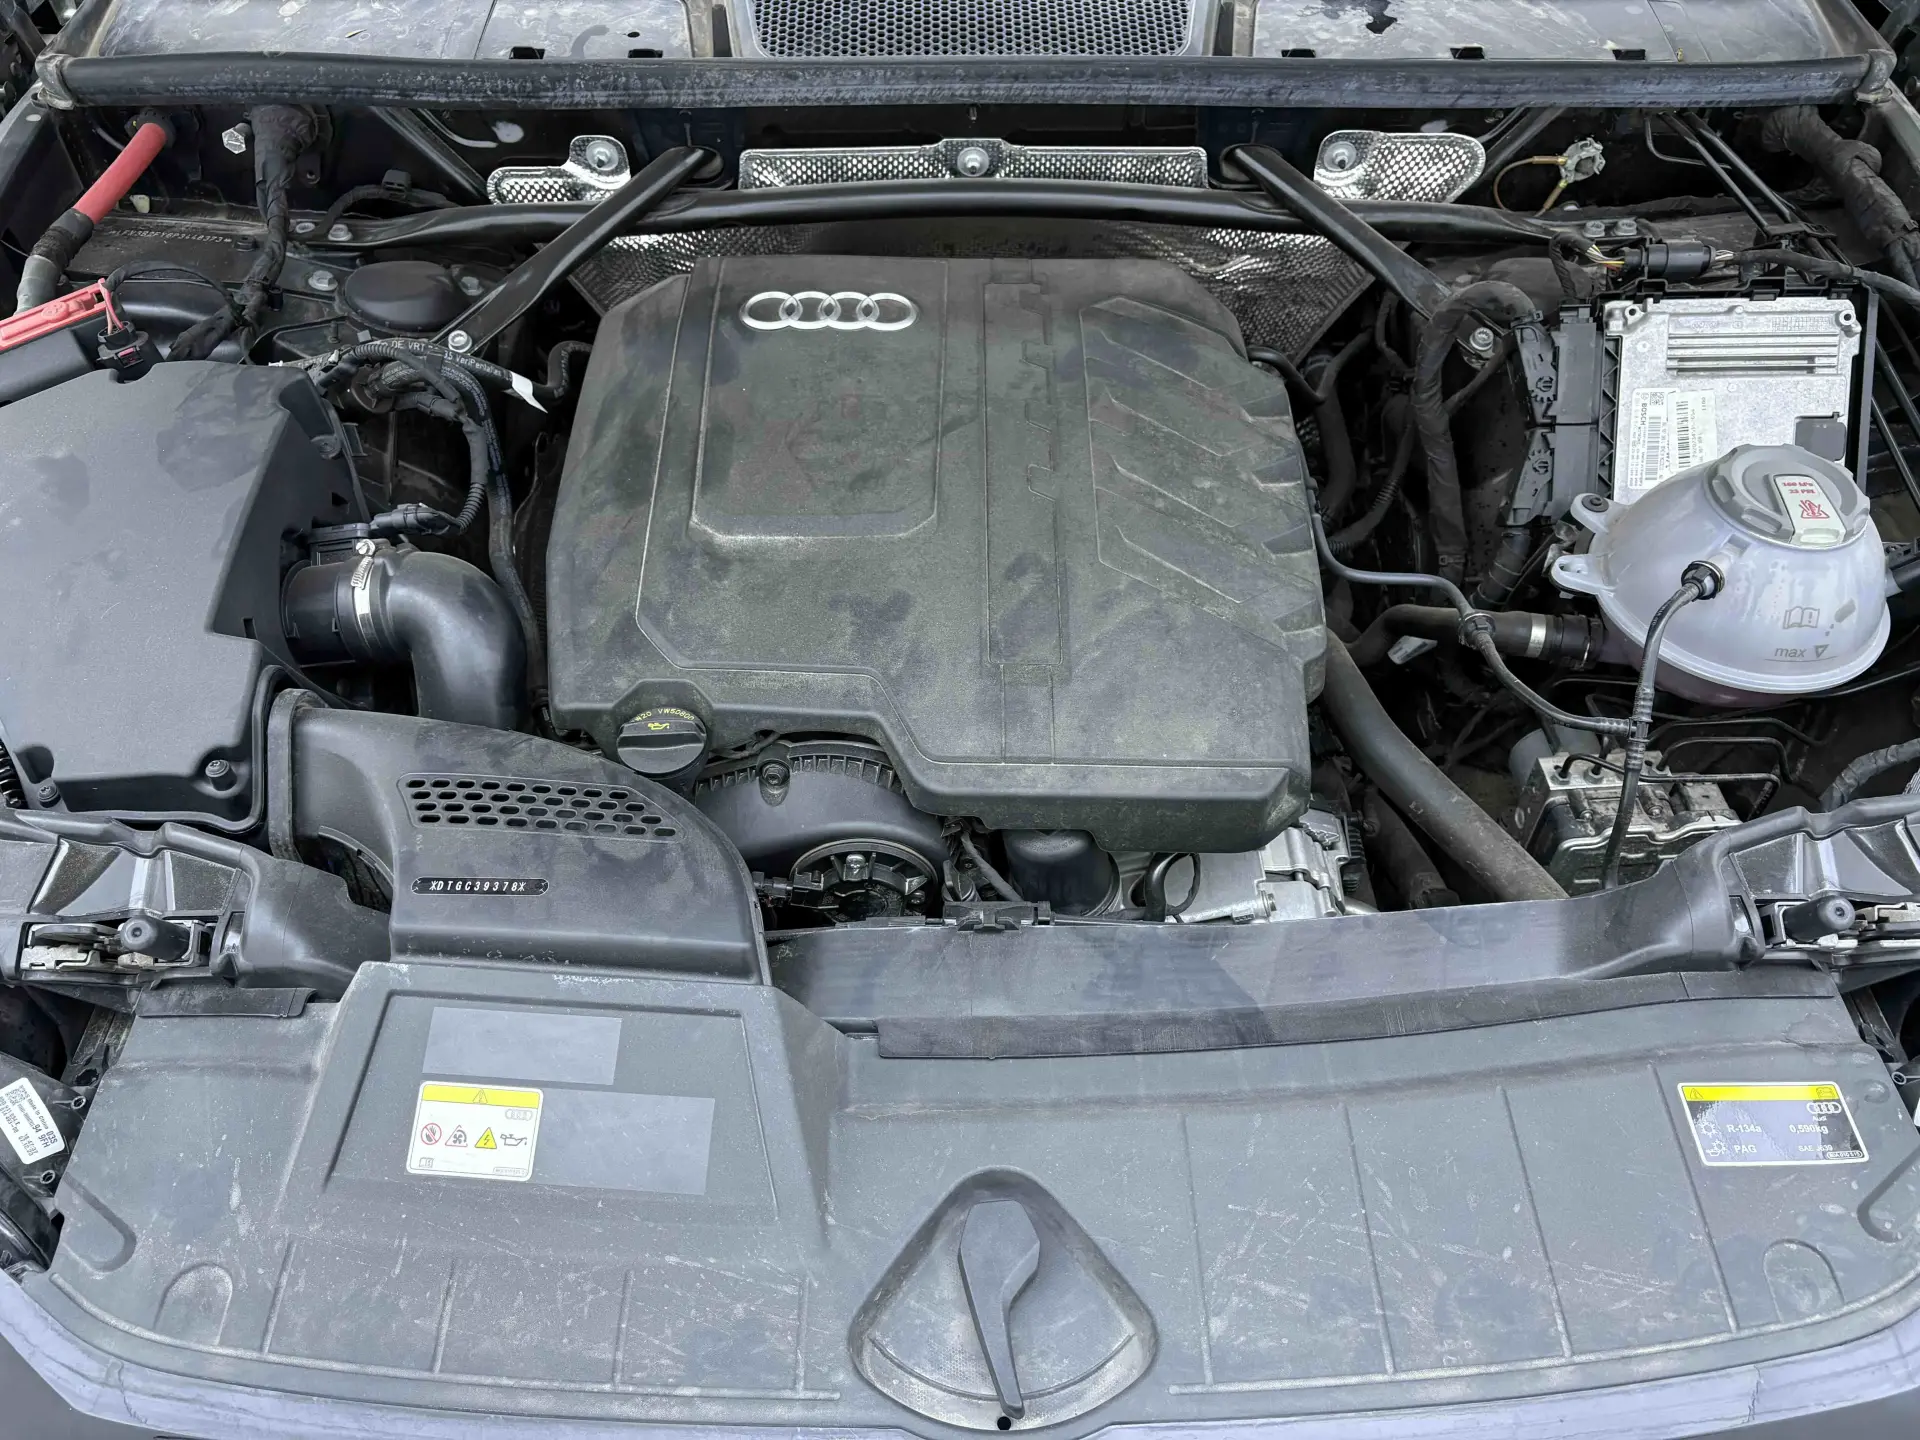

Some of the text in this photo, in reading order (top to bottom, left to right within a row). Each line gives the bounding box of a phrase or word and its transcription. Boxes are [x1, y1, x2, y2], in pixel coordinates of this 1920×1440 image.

[1640, 402, 1648, 425] BOSCH
[1774, 648, 1807, 658] max
[1726, 1124, 1829, 1134] R-134a 0,590kg
[1734, 1144, 1757, 1153] PAG
